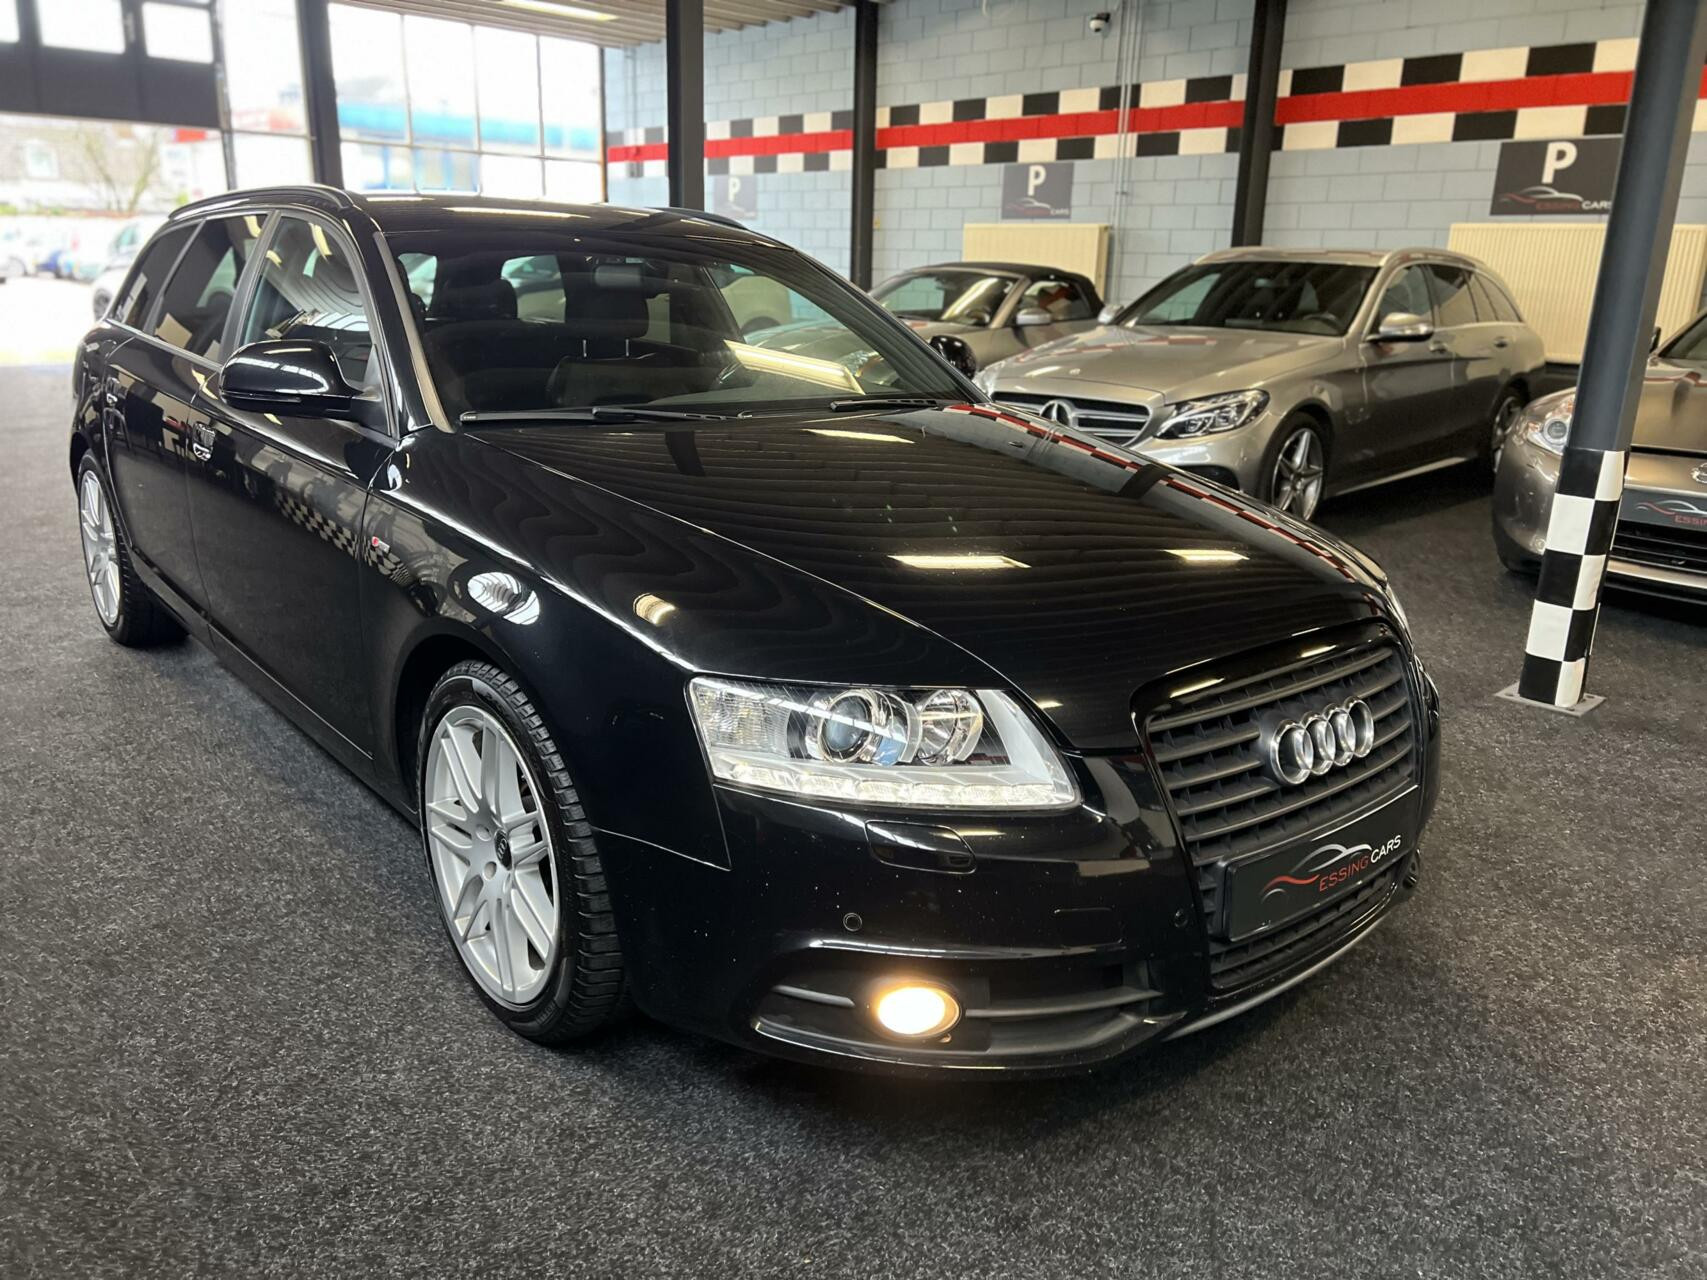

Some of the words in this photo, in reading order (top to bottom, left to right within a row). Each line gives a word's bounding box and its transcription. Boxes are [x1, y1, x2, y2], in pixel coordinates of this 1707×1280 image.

[1028, 165, 1046, 196] P
[1541, 141, 1577, 184] P
[728, 176, 741, 202] P
[1319, 855, 1370, 892] ESSING
[1370, 834, 1401, 864] CARS
